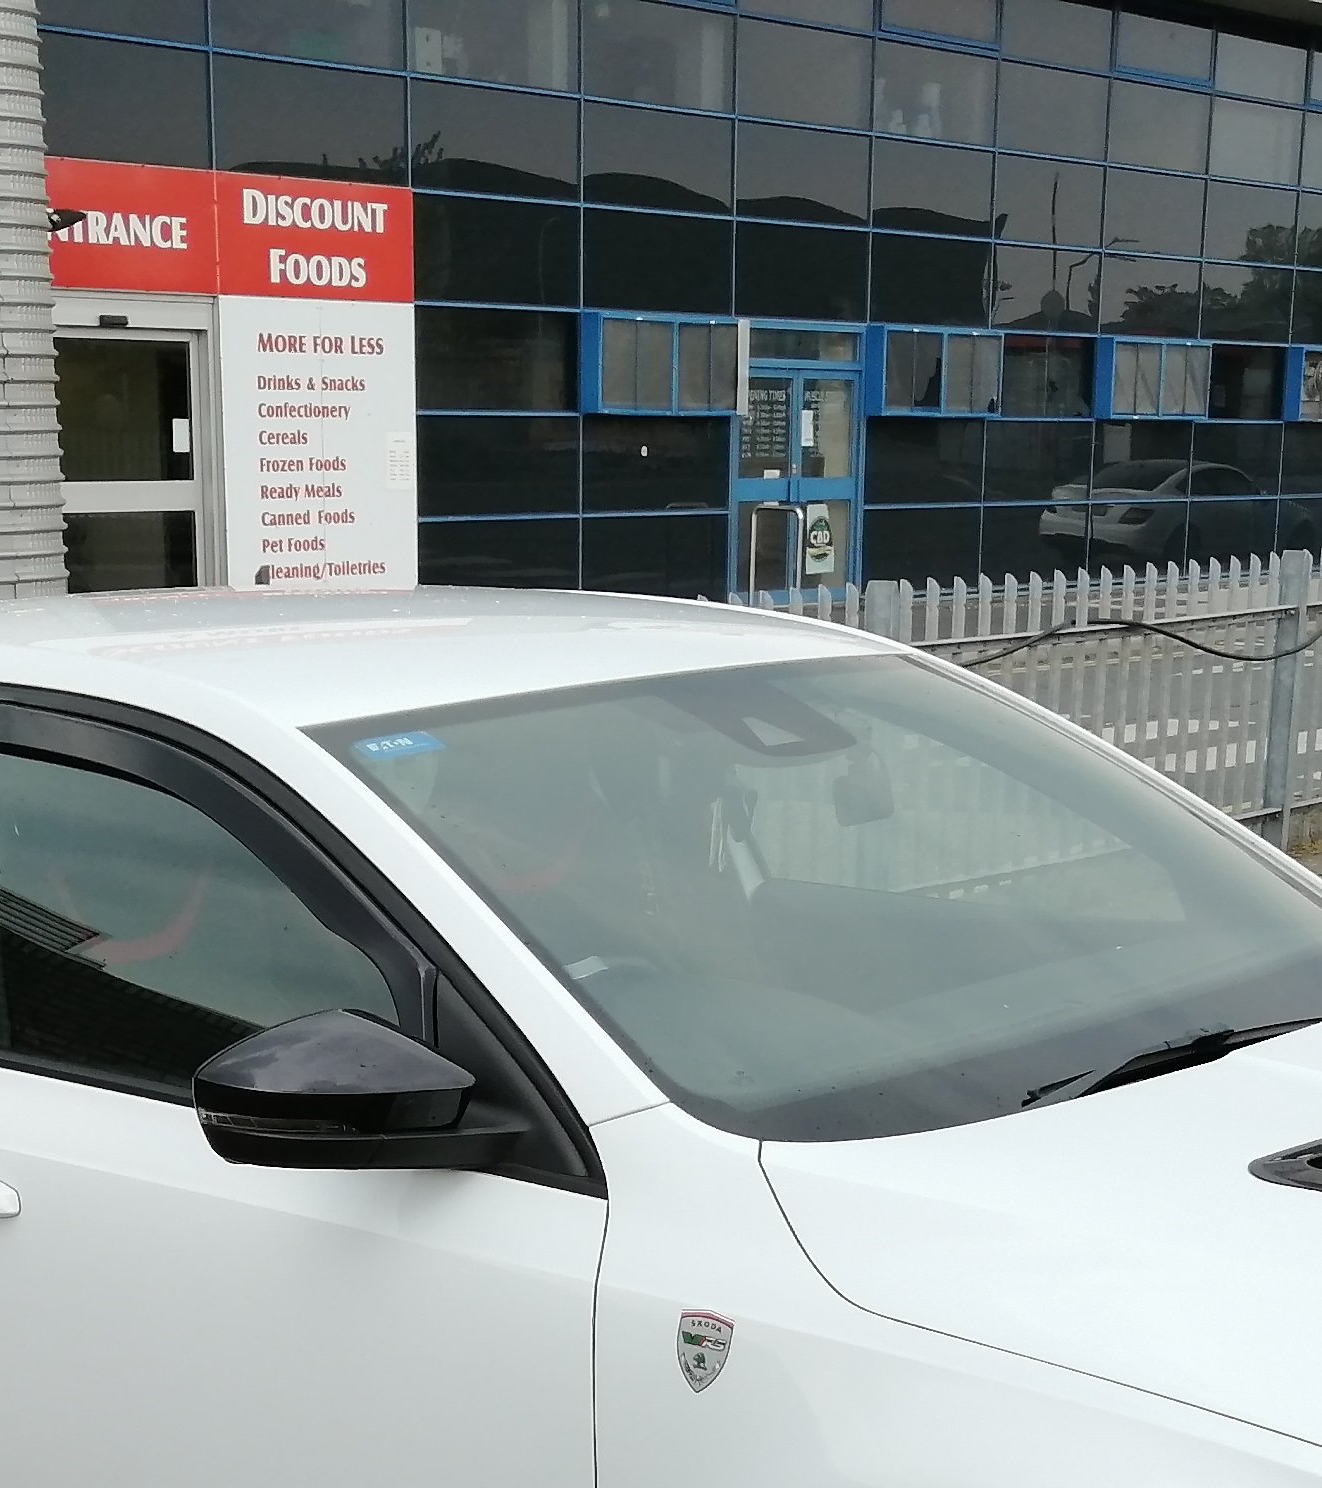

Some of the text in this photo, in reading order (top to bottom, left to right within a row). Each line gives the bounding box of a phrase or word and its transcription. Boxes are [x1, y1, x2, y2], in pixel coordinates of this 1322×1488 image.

[242, 188, 388, 233] DISCOUNT
[47, 210, 188, 249] TRANCE
[269, 248, 367, 288] FOODS
[257, 332, 384, 355] MORE FOR LESS
[257, 375, 366, 391] Drinks & Snacks
[258, 402, 350, 420] Confectionery
[259, 430, 308, 445] Cereals
[260, 456, 346, 472] Frozen Foods
[260, 482, 342, 501] Ready Meals
[261, 509, 355, 526] Canned Foods
[262, 536, 325, 553] Pet Foods
[267, 559, 386, 580] leaning/Toiletries
